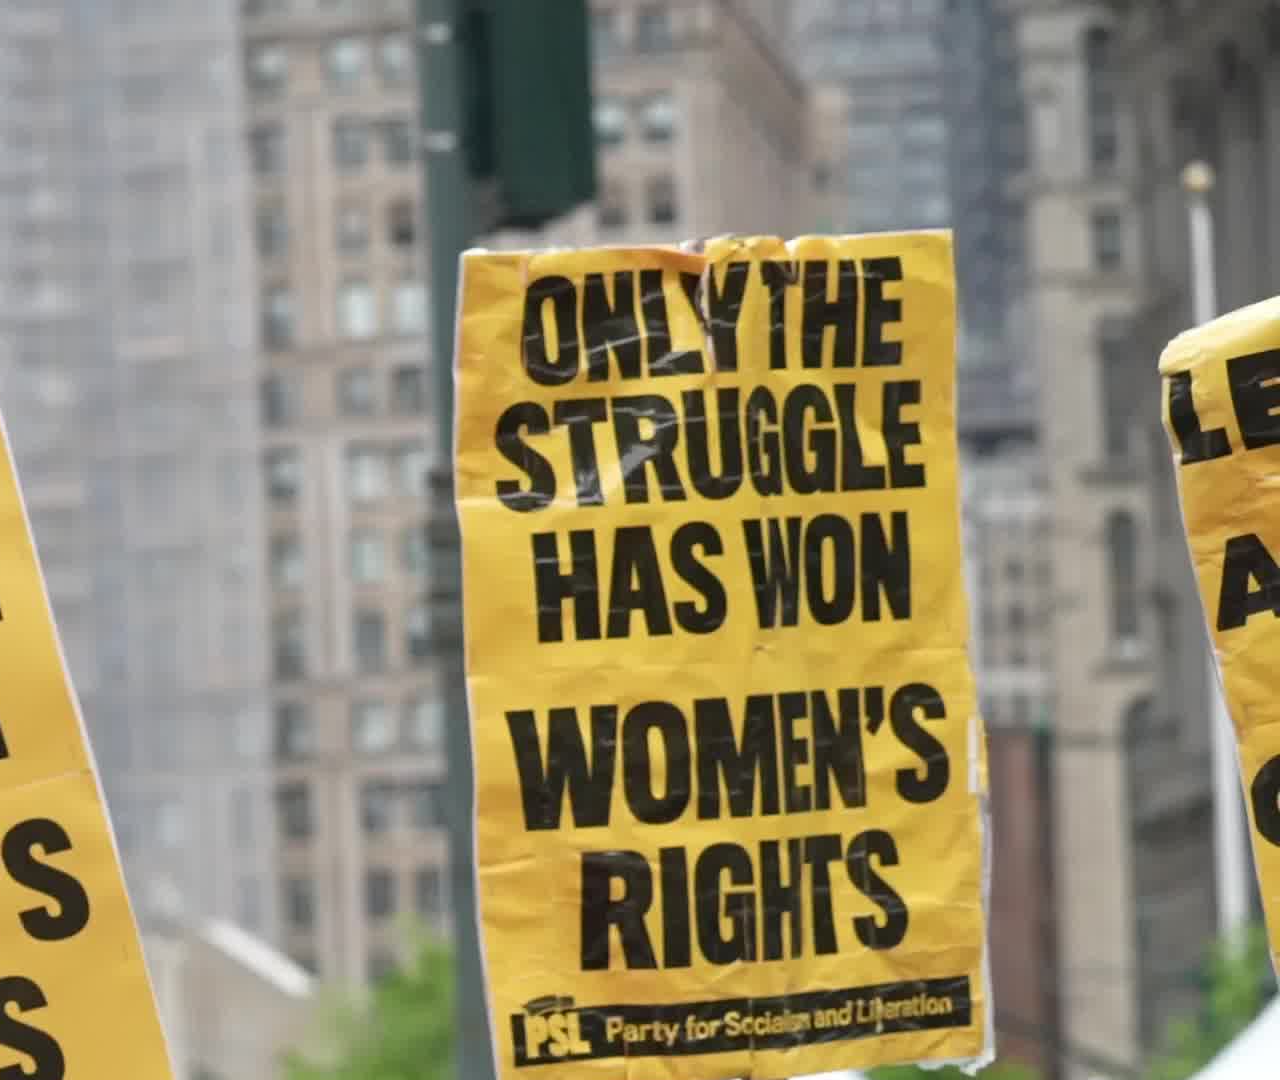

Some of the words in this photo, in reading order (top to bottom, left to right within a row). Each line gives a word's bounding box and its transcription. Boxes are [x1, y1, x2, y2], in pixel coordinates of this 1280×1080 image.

[522, 260, 748, 386] ONLY
[761, 257, 903, 371] THE
[495, 380, 926, 513] STRUGGLE
[532, 521, 728, 643] HAS
[744, 511, 912, 631] WON
[505, 683, 951, 831] WOMEN'S
[579, 828, 910, 971] RIGHTS
[526, 1010, 590, 1058] PSL
[605, 1016, 679, 1046] Party
[684, 1015, 720, 1039] for
[813, 1003, 849, 1027] and
